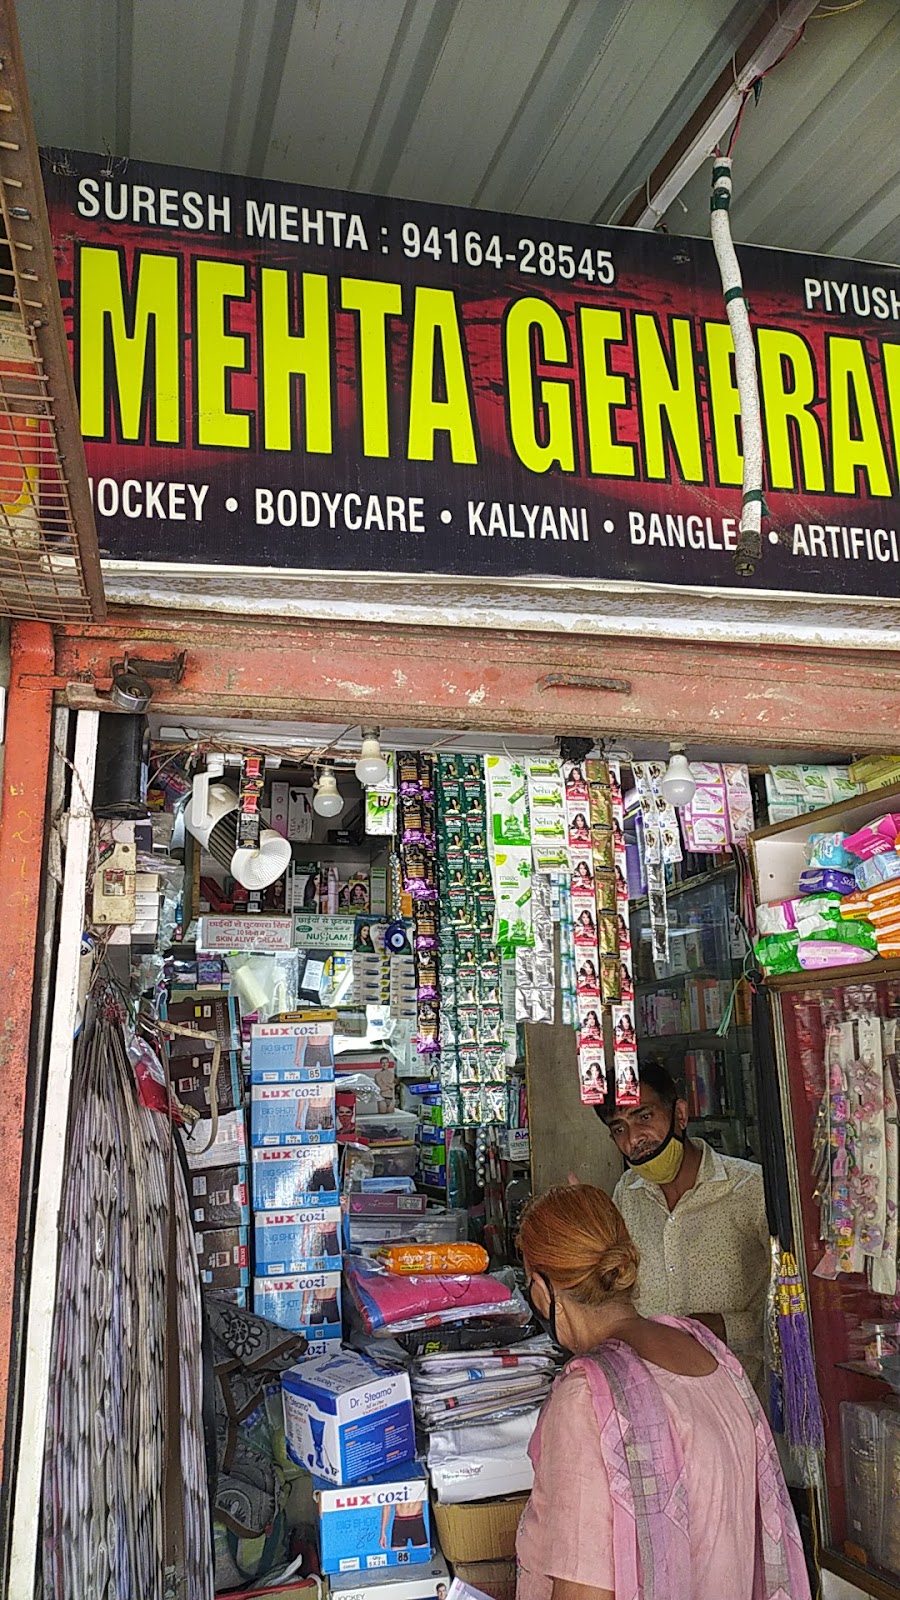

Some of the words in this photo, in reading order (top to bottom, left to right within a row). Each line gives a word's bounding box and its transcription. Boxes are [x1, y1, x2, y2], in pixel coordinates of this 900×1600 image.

[77, 178, 231, 233] SURESH
[247, 200, 368, 251] MEHTA
[402, 222, 615, 284] 94164-28545
[80, 247, 478, 465] MEHTA
[255, 488, 426, 533] BODYCARE
[467, 500, 589, 542] KALYANI
[629, 511, 741, 552] BANGLE
[793, 523, 900, 563] ARTIFICI
[234, 935, 256, 943] ALIVE
[261, 1028, 290, 1036] LUX
[294, 1023, 319, 1035] cozi
[309, 1069, 320, 1078] 85
[262, 1090, 291, 1098] LUX
[295, 1085, 320, 1097] cozi
[263, 1151, 291, 1160] LUX
[266, 1215, 295, 1224] LUX
[299, 1209, 326, 1222] cozi
[265, 1281, 294, 1292] LUX
[299, 1275, 326, 1289] cozi
[304, 1341, 327, 1356] ozi
[350, 1398, 363, 1408] Dr.
[364, 1387, 392, 1403] Steamo
[336, 1495, 371, 1508] LUX
[377, 1486, 409, 1504] cozi
[336, 1520, 351, 1530] BIG
[353, 1517, 377, 1527] SHOT
